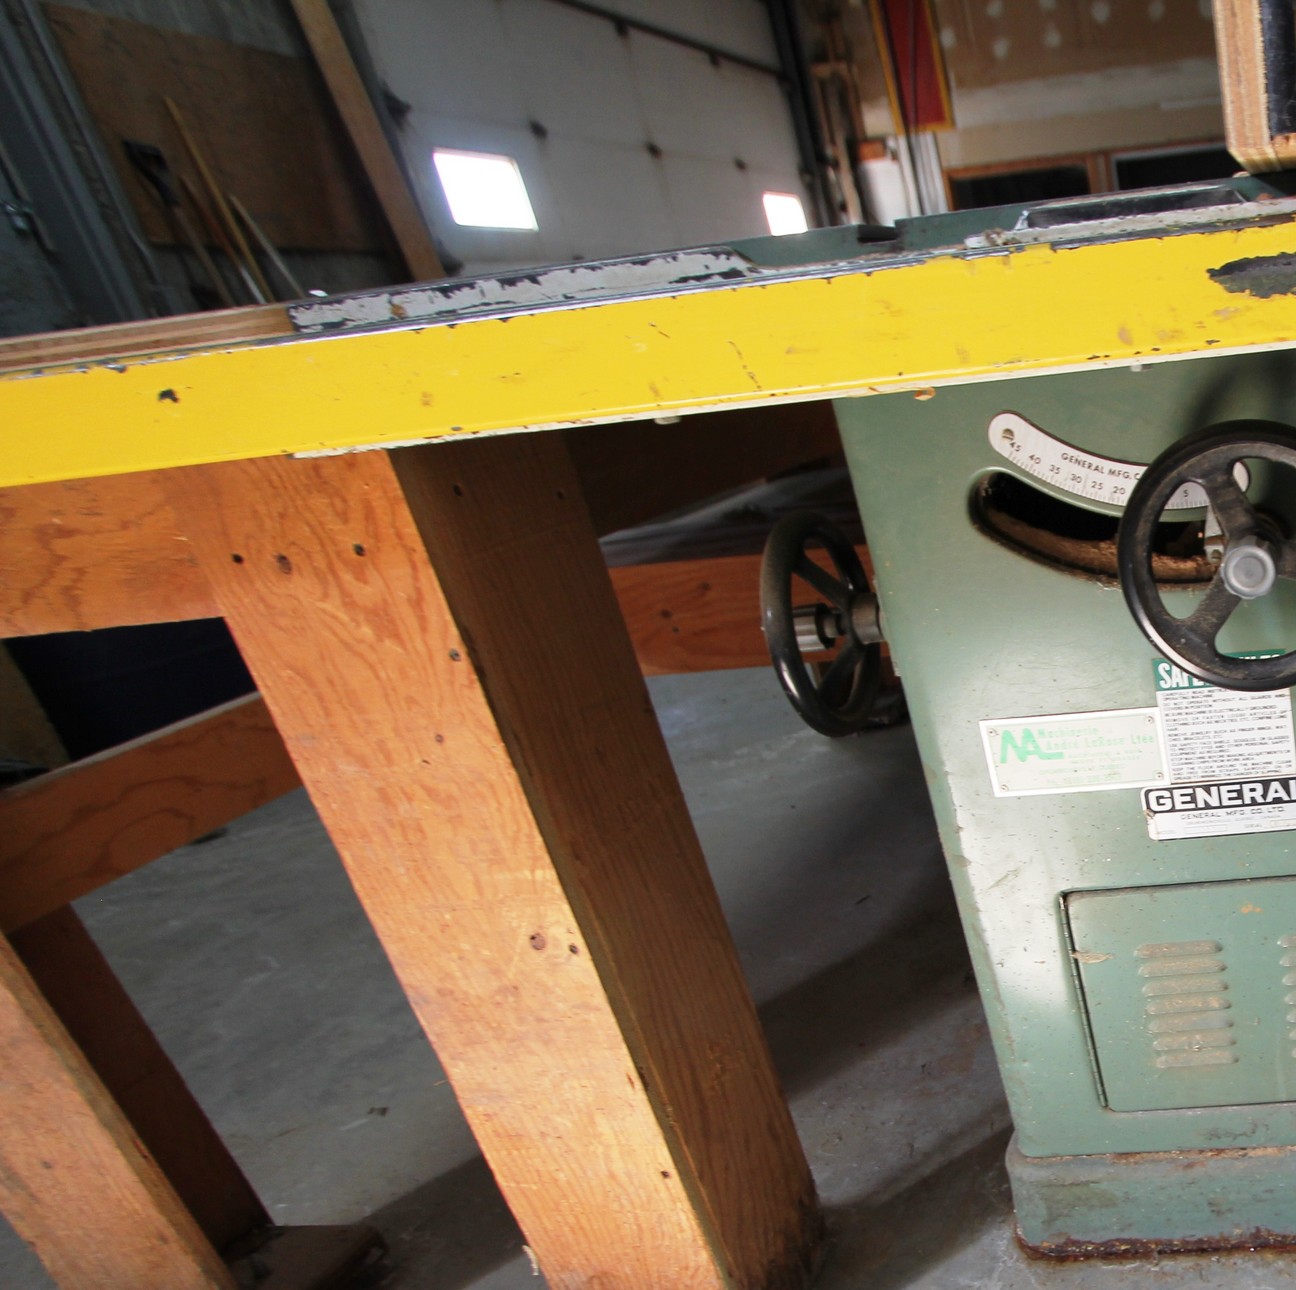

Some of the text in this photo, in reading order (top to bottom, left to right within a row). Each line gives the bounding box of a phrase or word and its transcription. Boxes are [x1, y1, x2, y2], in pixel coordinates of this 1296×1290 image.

[1010, 441, 1021, 452] 45
[1029, 454, 1041, 464] 40
[1049, 464, 1061, 475] 35
[1070, 473, 1082, 483] 30
[1091, 480, 1104, 490] 25
[1113, 486, 1126, 495] 20
[1061, 452, 1141, 481] GENERAL MFG. C
[1180, 811, 1221, 820] GENERAL
